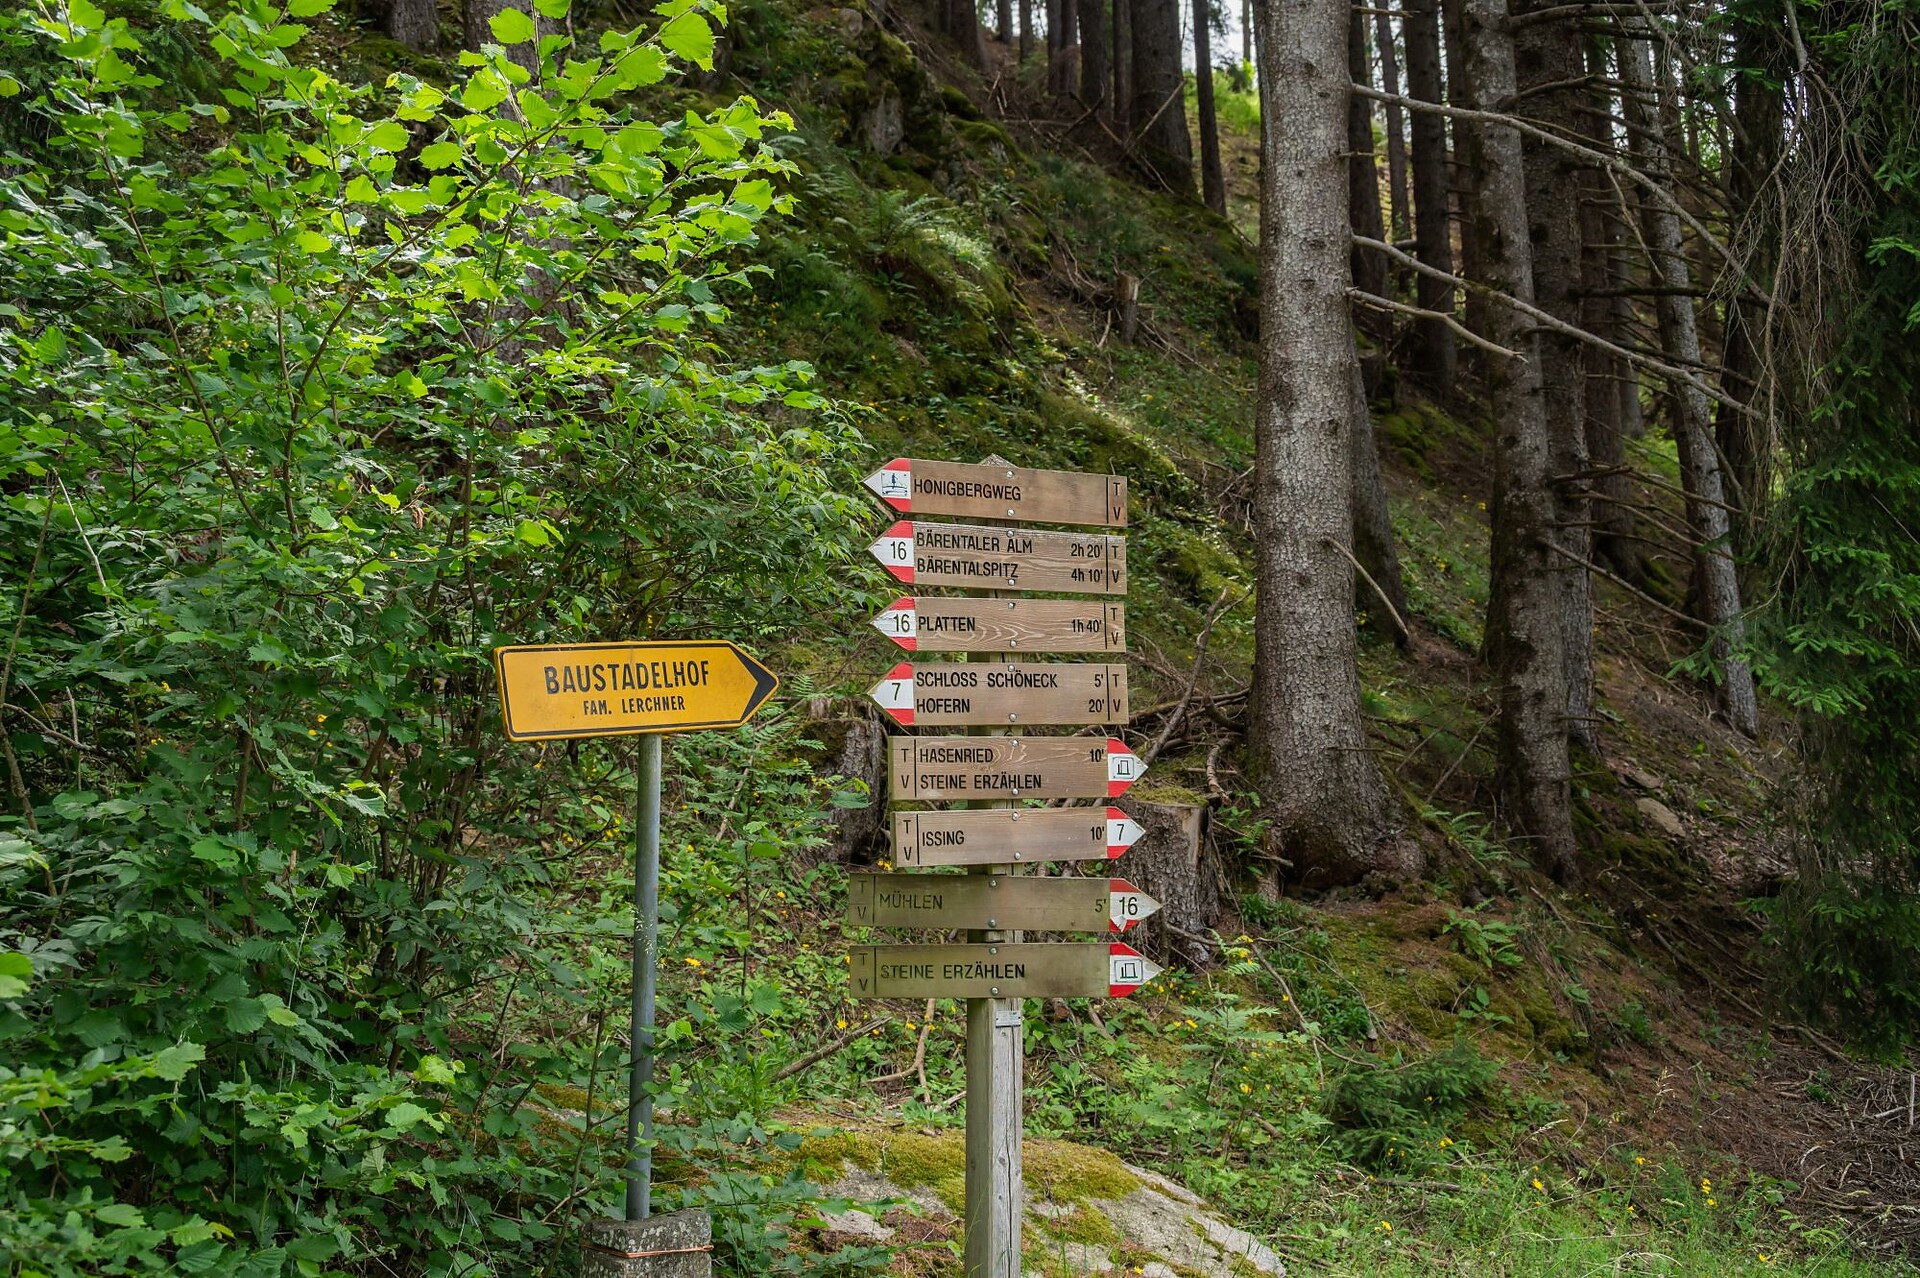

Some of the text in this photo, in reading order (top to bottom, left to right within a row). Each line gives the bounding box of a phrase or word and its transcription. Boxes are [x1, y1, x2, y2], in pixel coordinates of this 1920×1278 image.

[914, 479, 1020, 500] HONIGBERGWEG
[1113, 482, 1120, 495] T
[1113, 507, 1120, 520] V
[917, 531, 999, 552] BÄRENTALER
[891, 542, 906, 559] 16
[1071, 543, 1103, 557] 2h 20'
[1112, 546, 1119, 557] T
[917, 556, 1018, 577] BÄRENTALSPITZ
[1071, 569, 1103, 582] 4h 10'
[1112, 570, 1119, 583] V
[1111, 608, 1117, 620] T
[893, 614, 909, 632] 16
[918, 617, 975, 631] PLATTEN
[1072, 619, 1102, 633] 1h 40'
[1112, 632, 1118, 645] V
[544, 661, 709, 694] BAUSTADELHOF
[917, 670, 1057, 688] SCHLOSS SCHÖNECK
[1095, 674, 1103, 687] 5'
[1113, 675, 1119, 687] T
[892, 683, 900, 700] 7
[584, 696, 685, 715] FAM. LERCHNER
[917, 699, 970, 713] HOFERN
[1089, 699, 1105, 712] 20'
[1113, 699, 1120, 712] V
[901, 749, 909, 762] T
[920, 749, 993, 762] HASENRIED
[1090, 749, 1104, 762] 10'
[901, 776, 909, 788] V
[920, 773, 1041, 789] STEINE ERZÄHLEN
[903, 820, 911, 834] T
[1091, 827, 1104, 840] 10'
[1117, 824, 1124, 841] 7
[922, 831, 964, 846] ISSING
[904, 847, 912, 861] V
[860, 881, 866, 893] T
[880, 892, 942, 909] MÜHLEN
[1119, 897, 1138, 915] 16
[858, 907, 866, 919] V
[859, 953, 867, 964] T
[881, 962, 1024, 979] STEINE ERZÄHLEN
[860, 979, 868, 991] V
